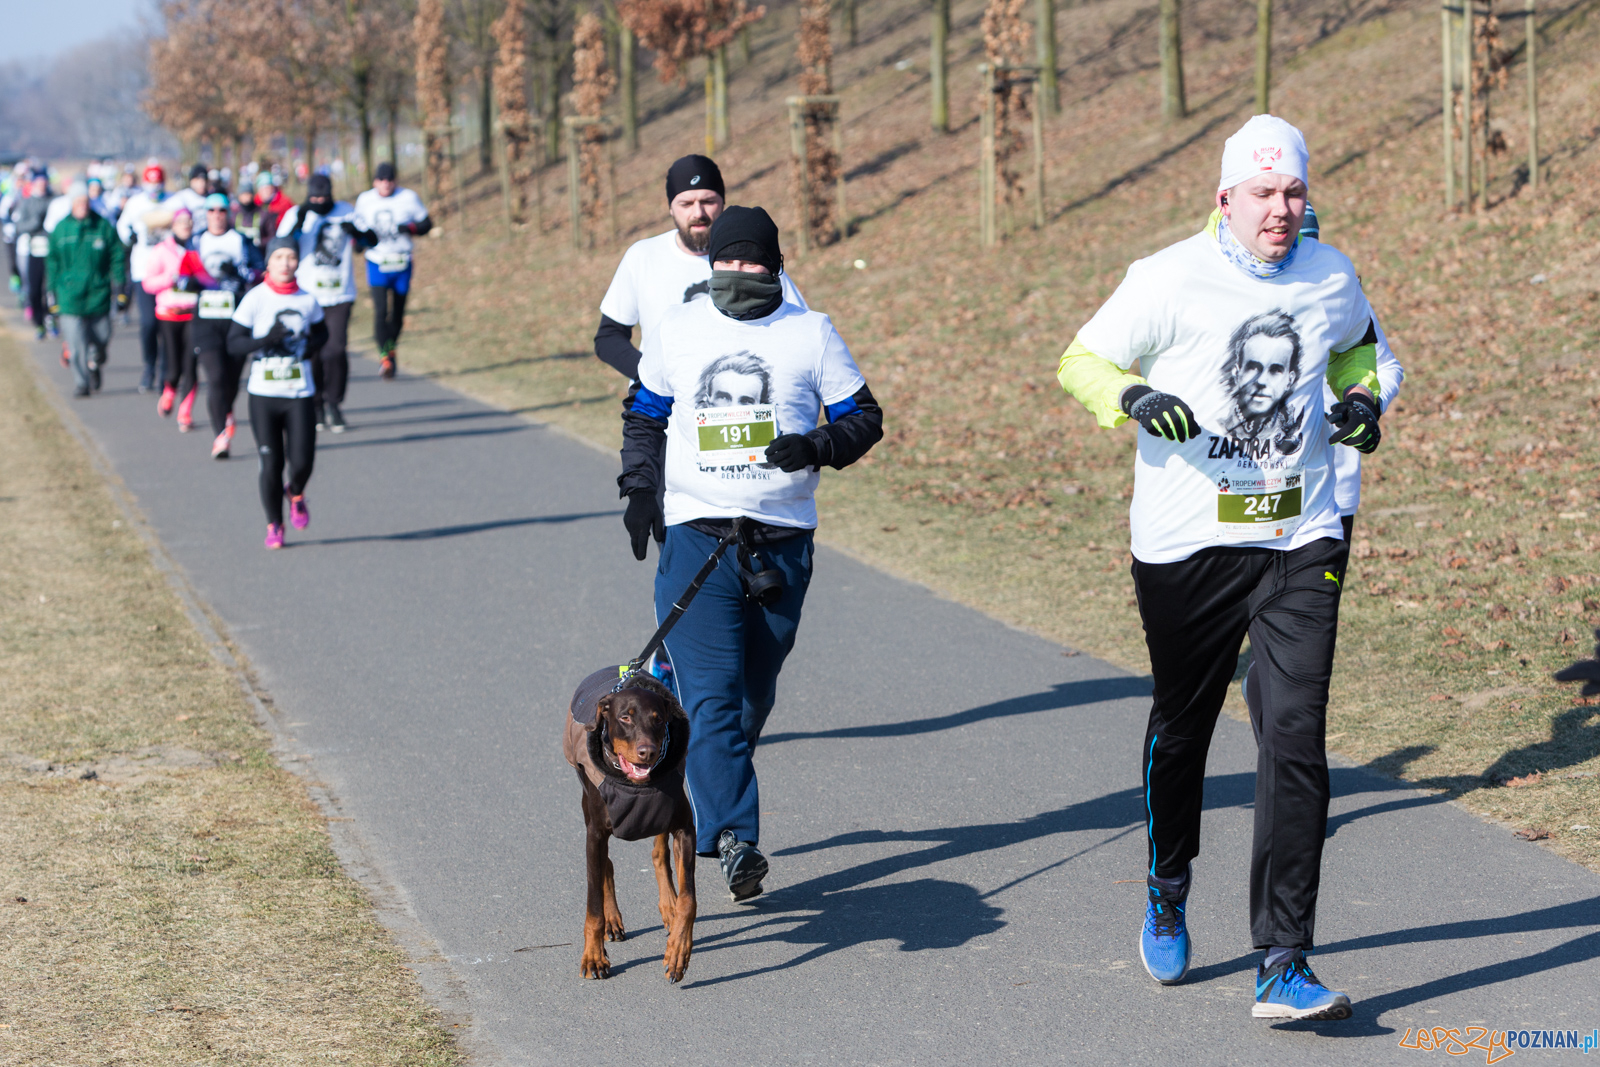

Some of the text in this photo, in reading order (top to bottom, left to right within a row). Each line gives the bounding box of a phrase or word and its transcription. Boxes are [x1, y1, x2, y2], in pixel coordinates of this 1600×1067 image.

[720, 425, 751, 443] 191
[721, 472, 771, 480] DEKUTOWSKI
[1243, 494, 1282, 515] 247
